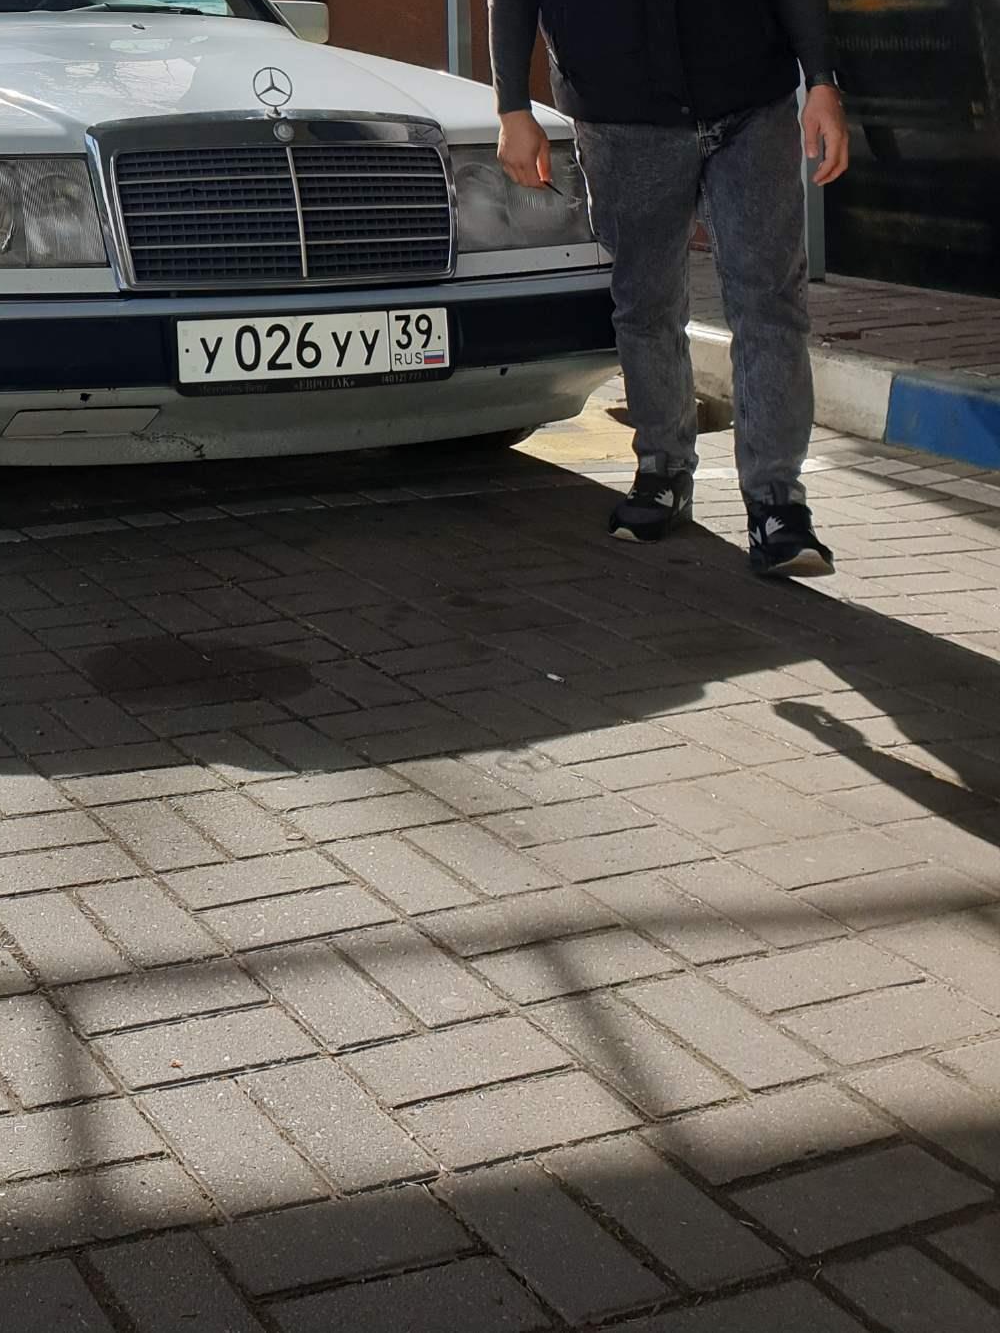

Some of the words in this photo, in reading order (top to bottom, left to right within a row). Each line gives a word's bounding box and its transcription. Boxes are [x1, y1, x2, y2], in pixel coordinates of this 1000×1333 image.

[199, 322, 380, 373] У026УУ
[394, 314, 433, 349] 39
[394, 352, 423, 365] RUS
